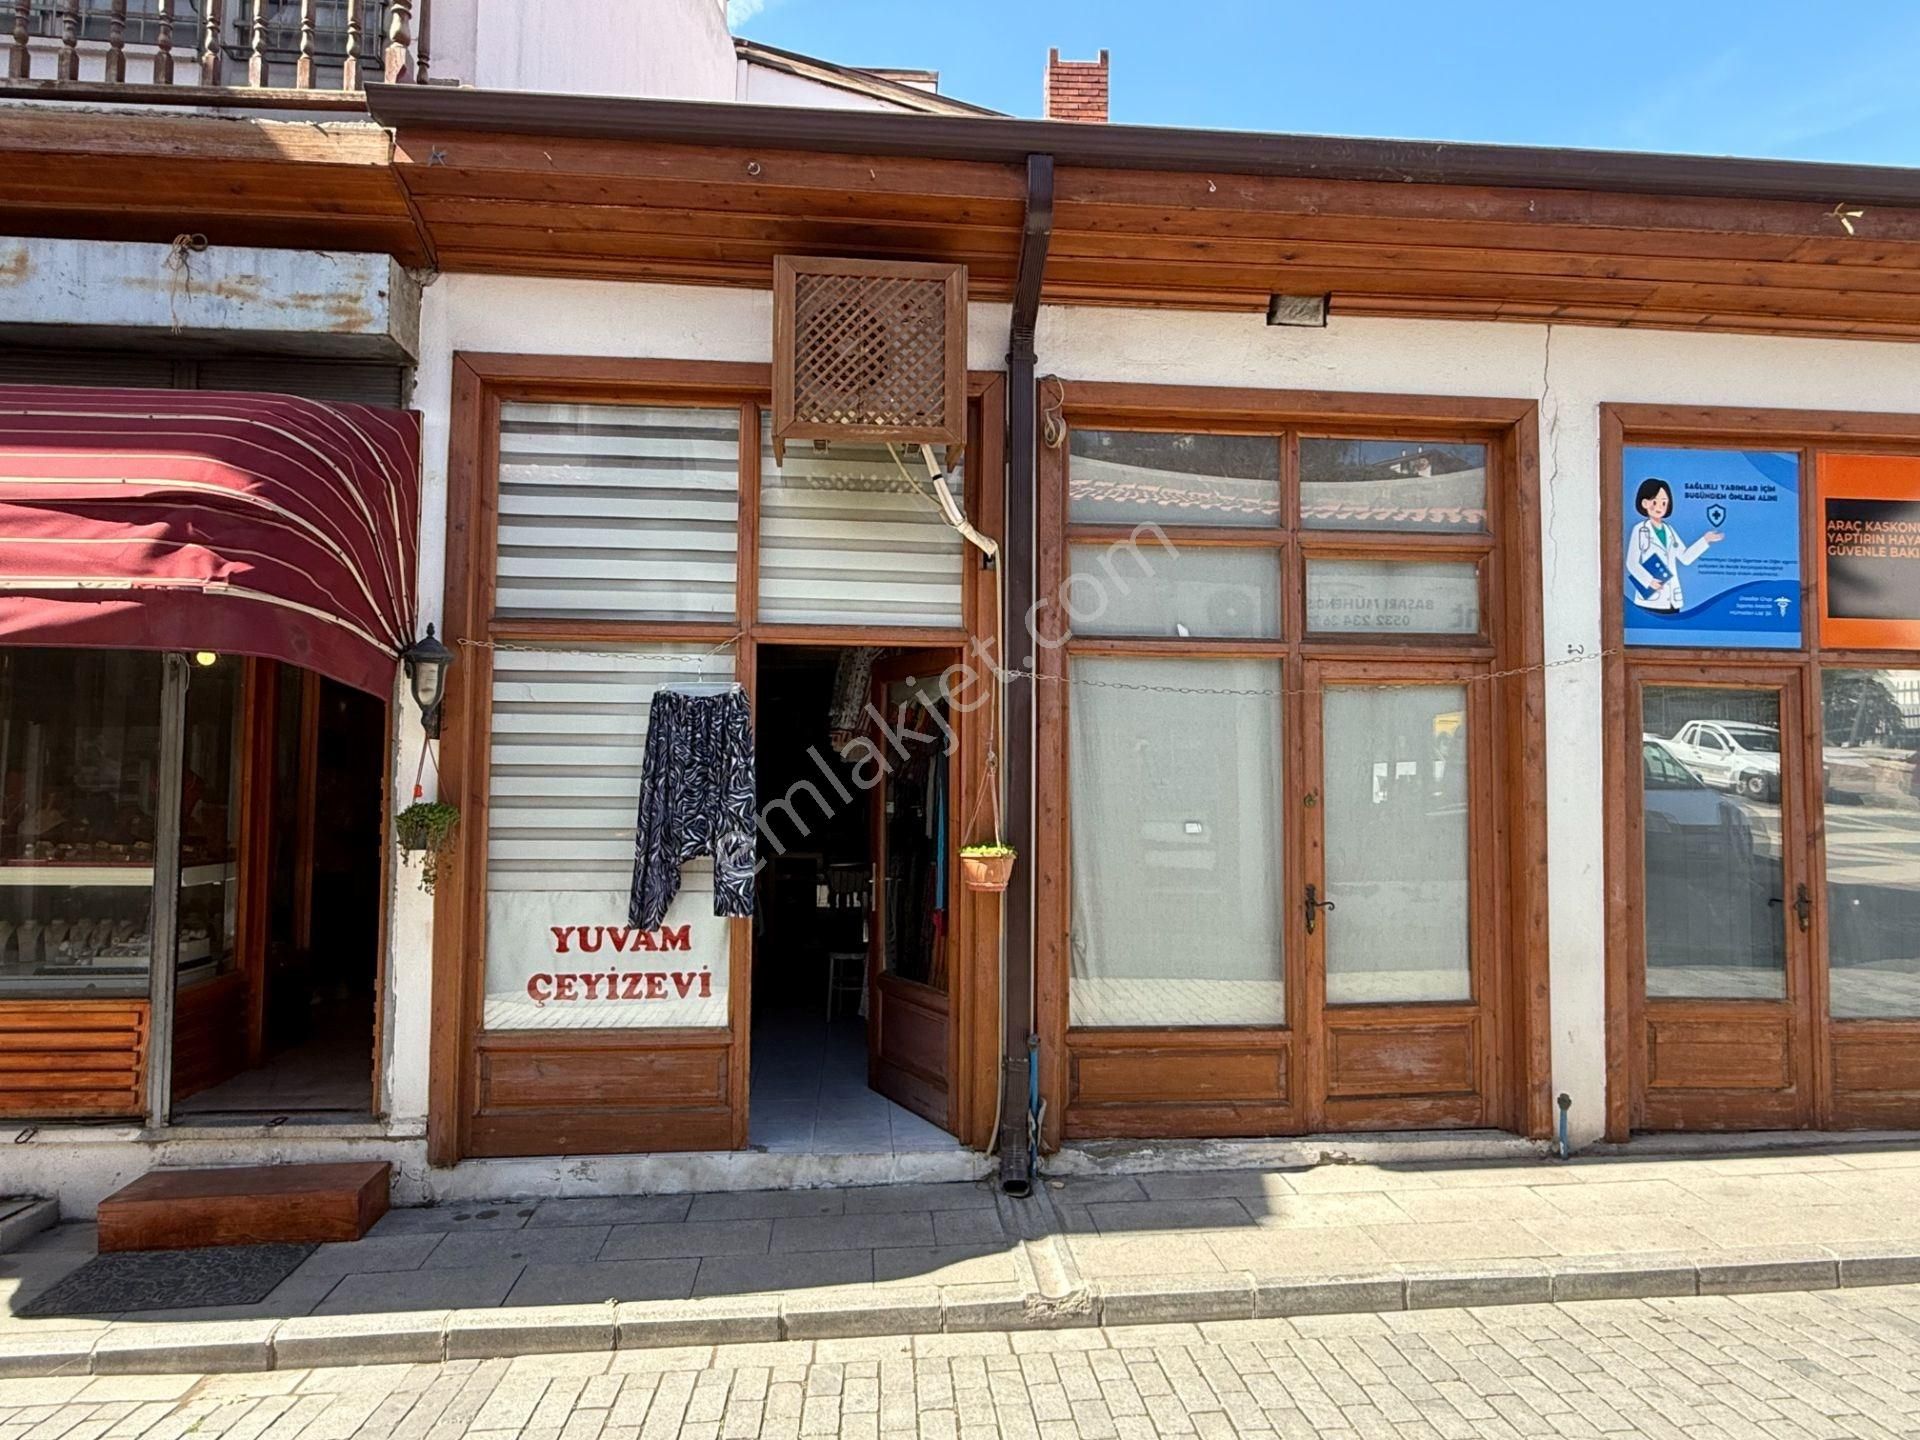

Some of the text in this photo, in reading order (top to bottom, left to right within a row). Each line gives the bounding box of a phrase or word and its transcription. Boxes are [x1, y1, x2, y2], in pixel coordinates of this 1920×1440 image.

[1827, 519, 1862, 533] ARAÇ
[1827, 533, 1885, 545] YAPTIRIN
[1827, 543, 1887, 557] GÜVENLE
[551, 924, 692, 953] YUVAM
[527, 964, 712, 1008] ÇEYİZEVİ
